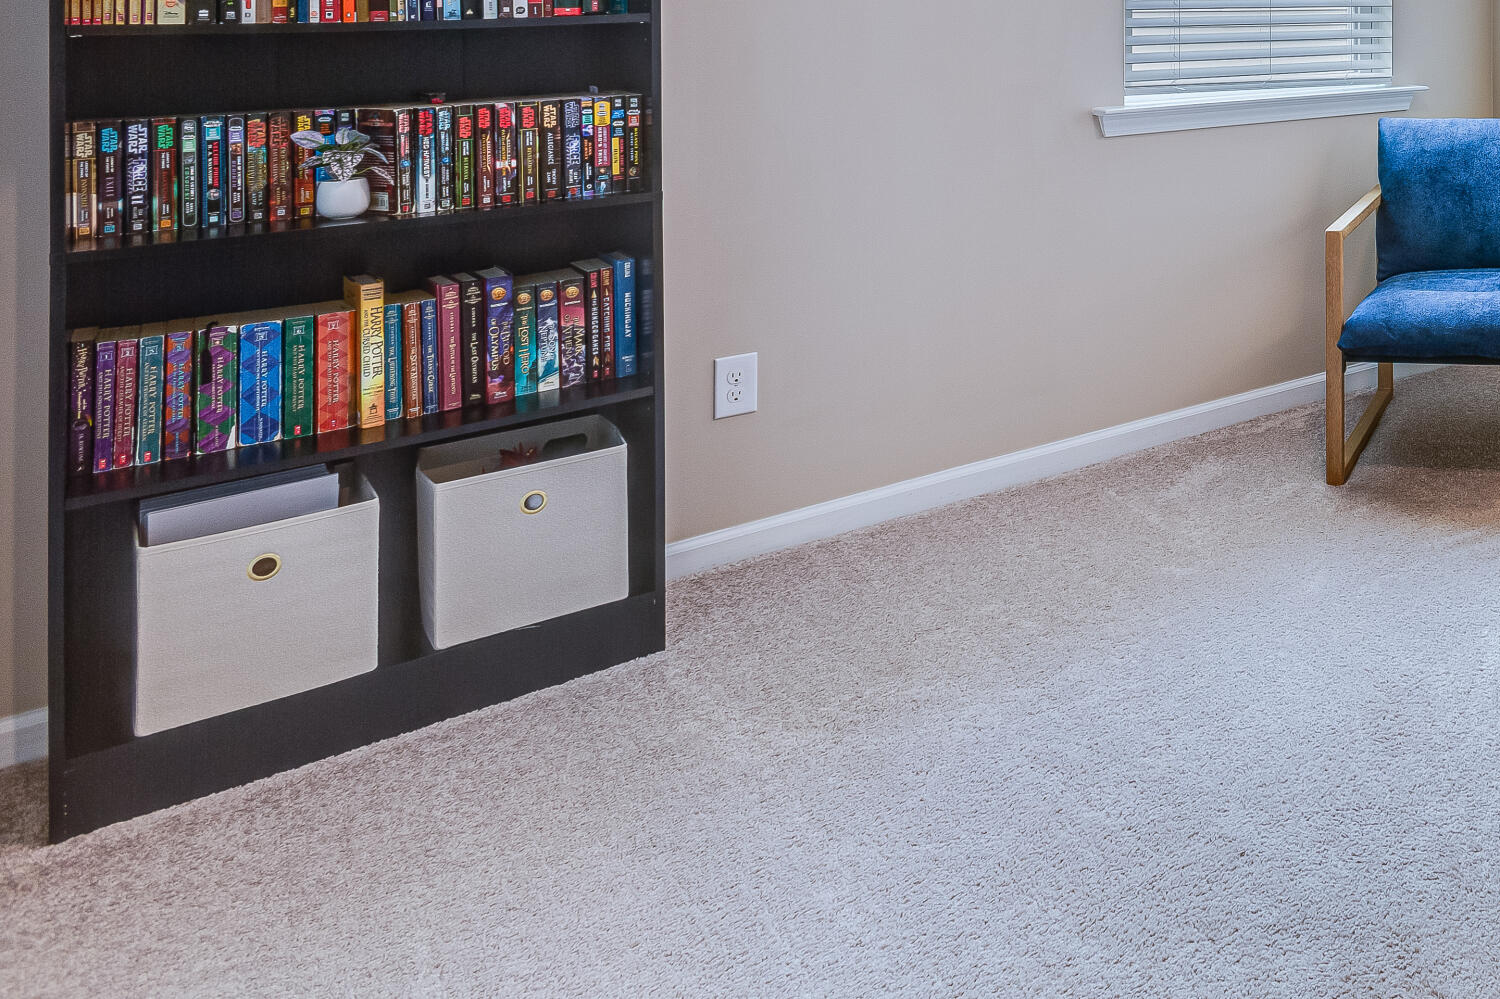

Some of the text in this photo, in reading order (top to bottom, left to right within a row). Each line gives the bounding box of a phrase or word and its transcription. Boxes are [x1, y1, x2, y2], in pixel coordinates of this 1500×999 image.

[418, 111, 427, 135] WARS
[459, 116, 467, 138] WARS
[522, 106, 530, 128] WARS
[543, 105, 551, 128] WARS
[76, 133, 86, 157] WARS
[84, 134, 92, 156] STAR
[102, 128, 111, 152] WARS
[128, 125, 138, 153] WARS
[138, 124, 148, 153] STAR
[157, 125, 167, 149] WARS
[165, 124, 174, 147] STAR
[248, 120, 259, 148] WARS
[258, 120, 266, 145] STAR
[623, 292, 631, 338] MOCKINGJAY
[362, 328, 370, 353] CURSED
[369, 307, 383, 378] HARRY POTTER
[489, 326, 499, 371] OLYMPUS
[500, 331, 510, 365] BLOOD
[517, 325, 529, 374] LOST HERO
[564, 325, 573, 360] ATHENA
[574, 328, 583, 355] MARK
[590, 335, 599, 355] GAMES
[259, 351, 268, 407] HARRY POTTER
[362, 356, 370, 378] CHILD
[176, 363, 185, 419] HARRY POTTER
[215, 357, 224, 414] HARRY POTTER
[101, 369, 111, 438] HARRY POTTER
[121, 368, 132, 436] HARRY POTTER
[147, 366, 157, 434] HARRY POTTER
